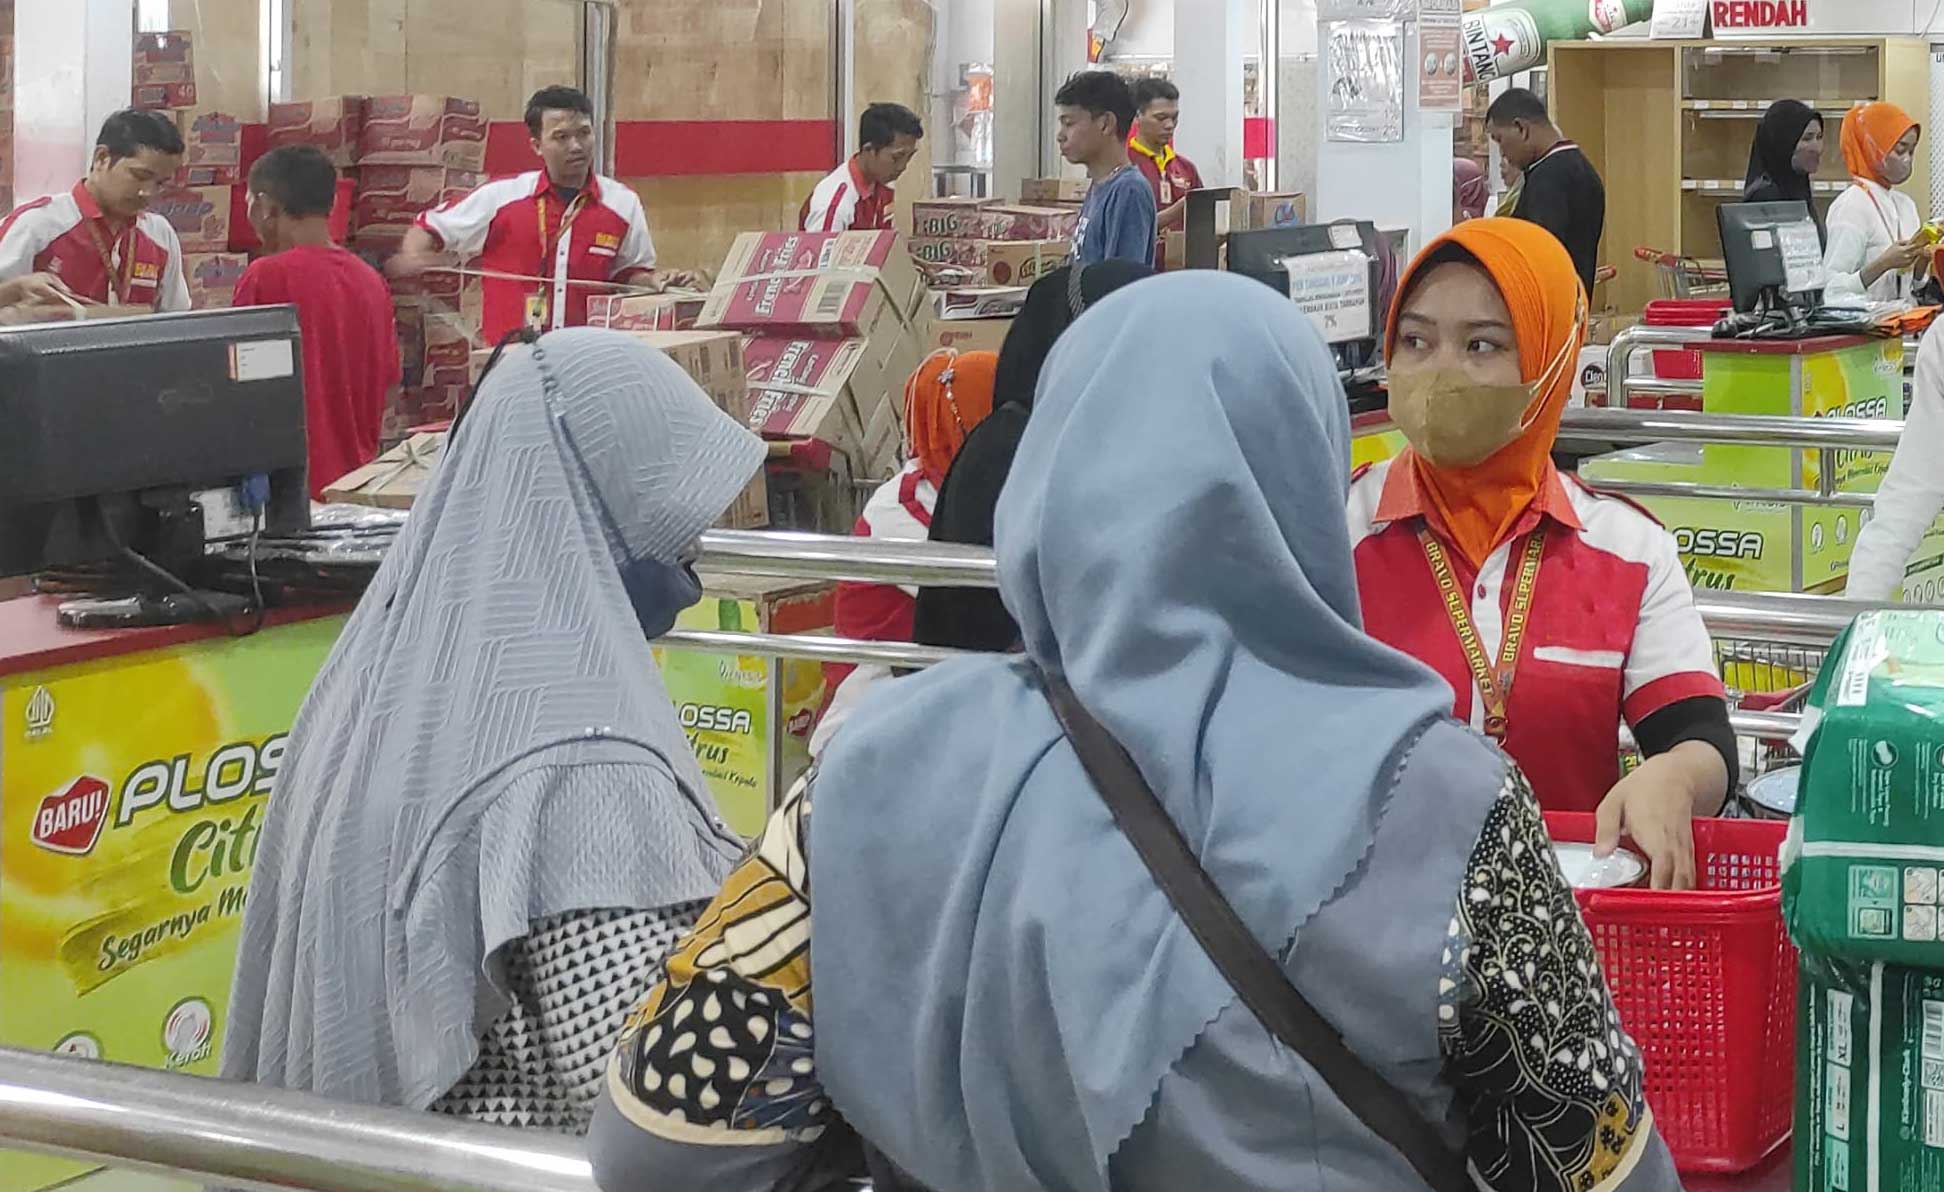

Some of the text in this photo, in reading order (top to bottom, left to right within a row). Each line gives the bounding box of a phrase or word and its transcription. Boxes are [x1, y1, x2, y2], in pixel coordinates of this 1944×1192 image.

[1713, 1, 1807, 27] RENDAH
[1463, 19, 1497, 81] BINTANG
[1426, 541, 1453, 589] BRAVO
[1502, 613, 1524, 662] BRAVO
[39, 789, 102, 838] BARU!
[98, 905, 212, 972] Segarnya
